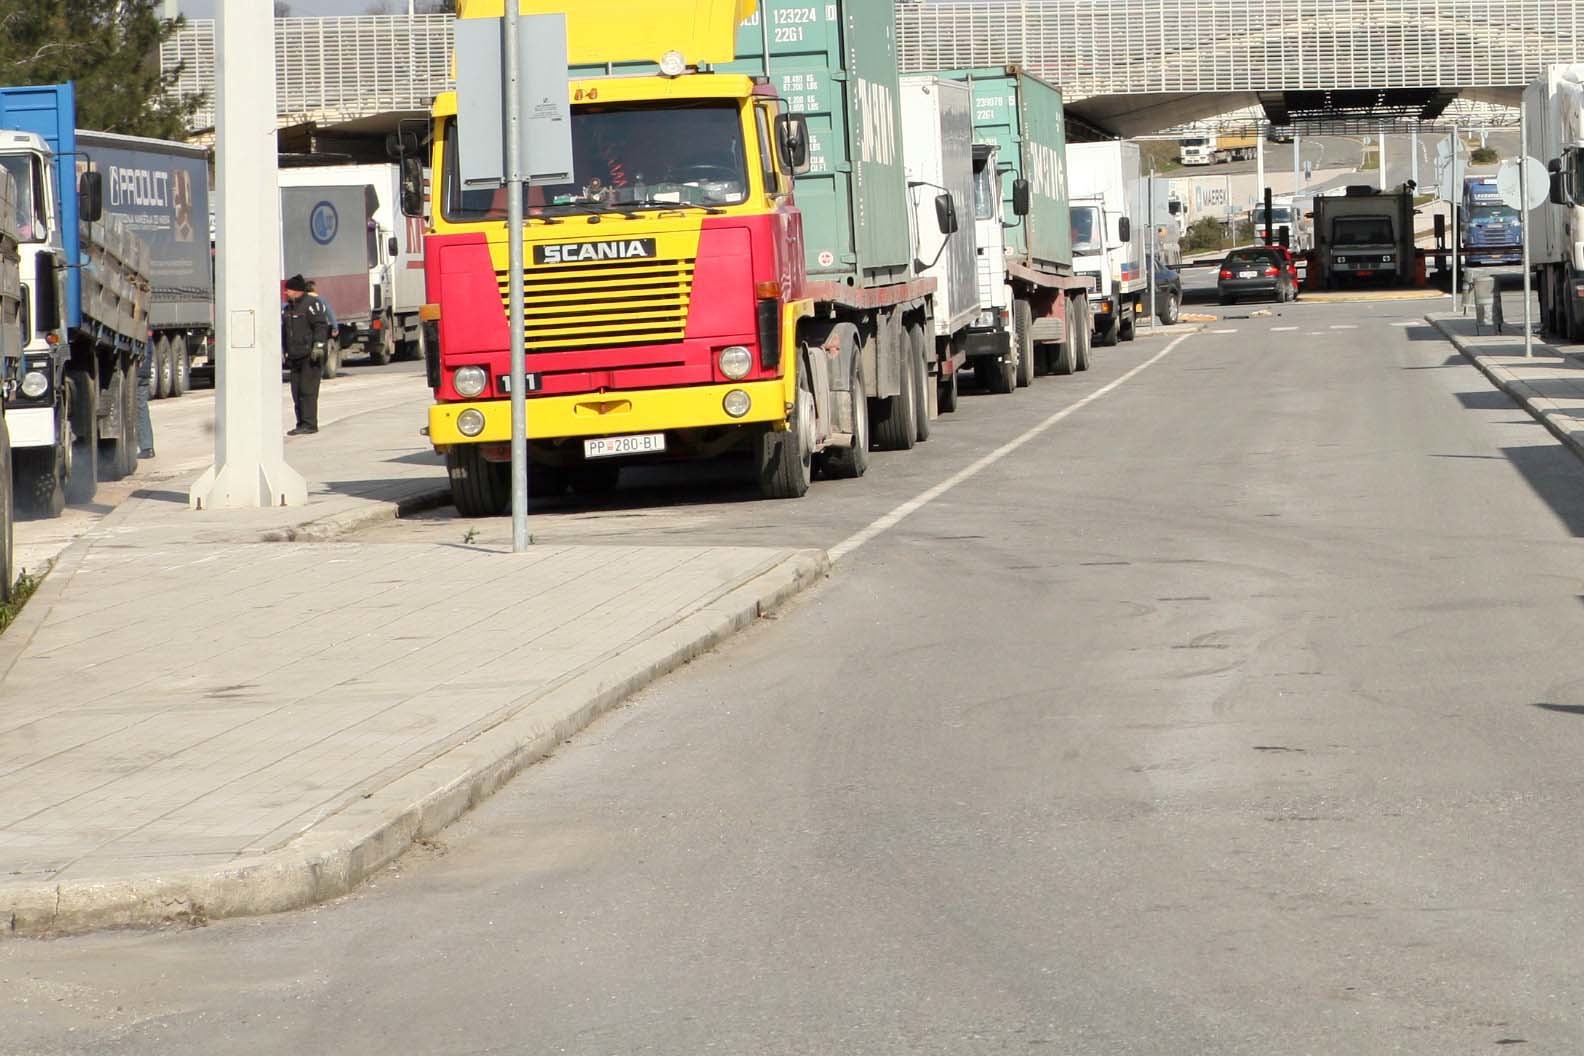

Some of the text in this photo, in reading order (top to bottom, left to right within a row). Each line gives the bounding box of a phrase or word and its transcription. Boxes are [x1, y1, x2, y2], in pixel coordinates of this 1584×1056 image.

[773, 7, 817, 25] 123224
[774, 26, 804, 42] 22G1
[543, 239, 649, 264] SCANIA
[589, 441, 605, 456] PP
